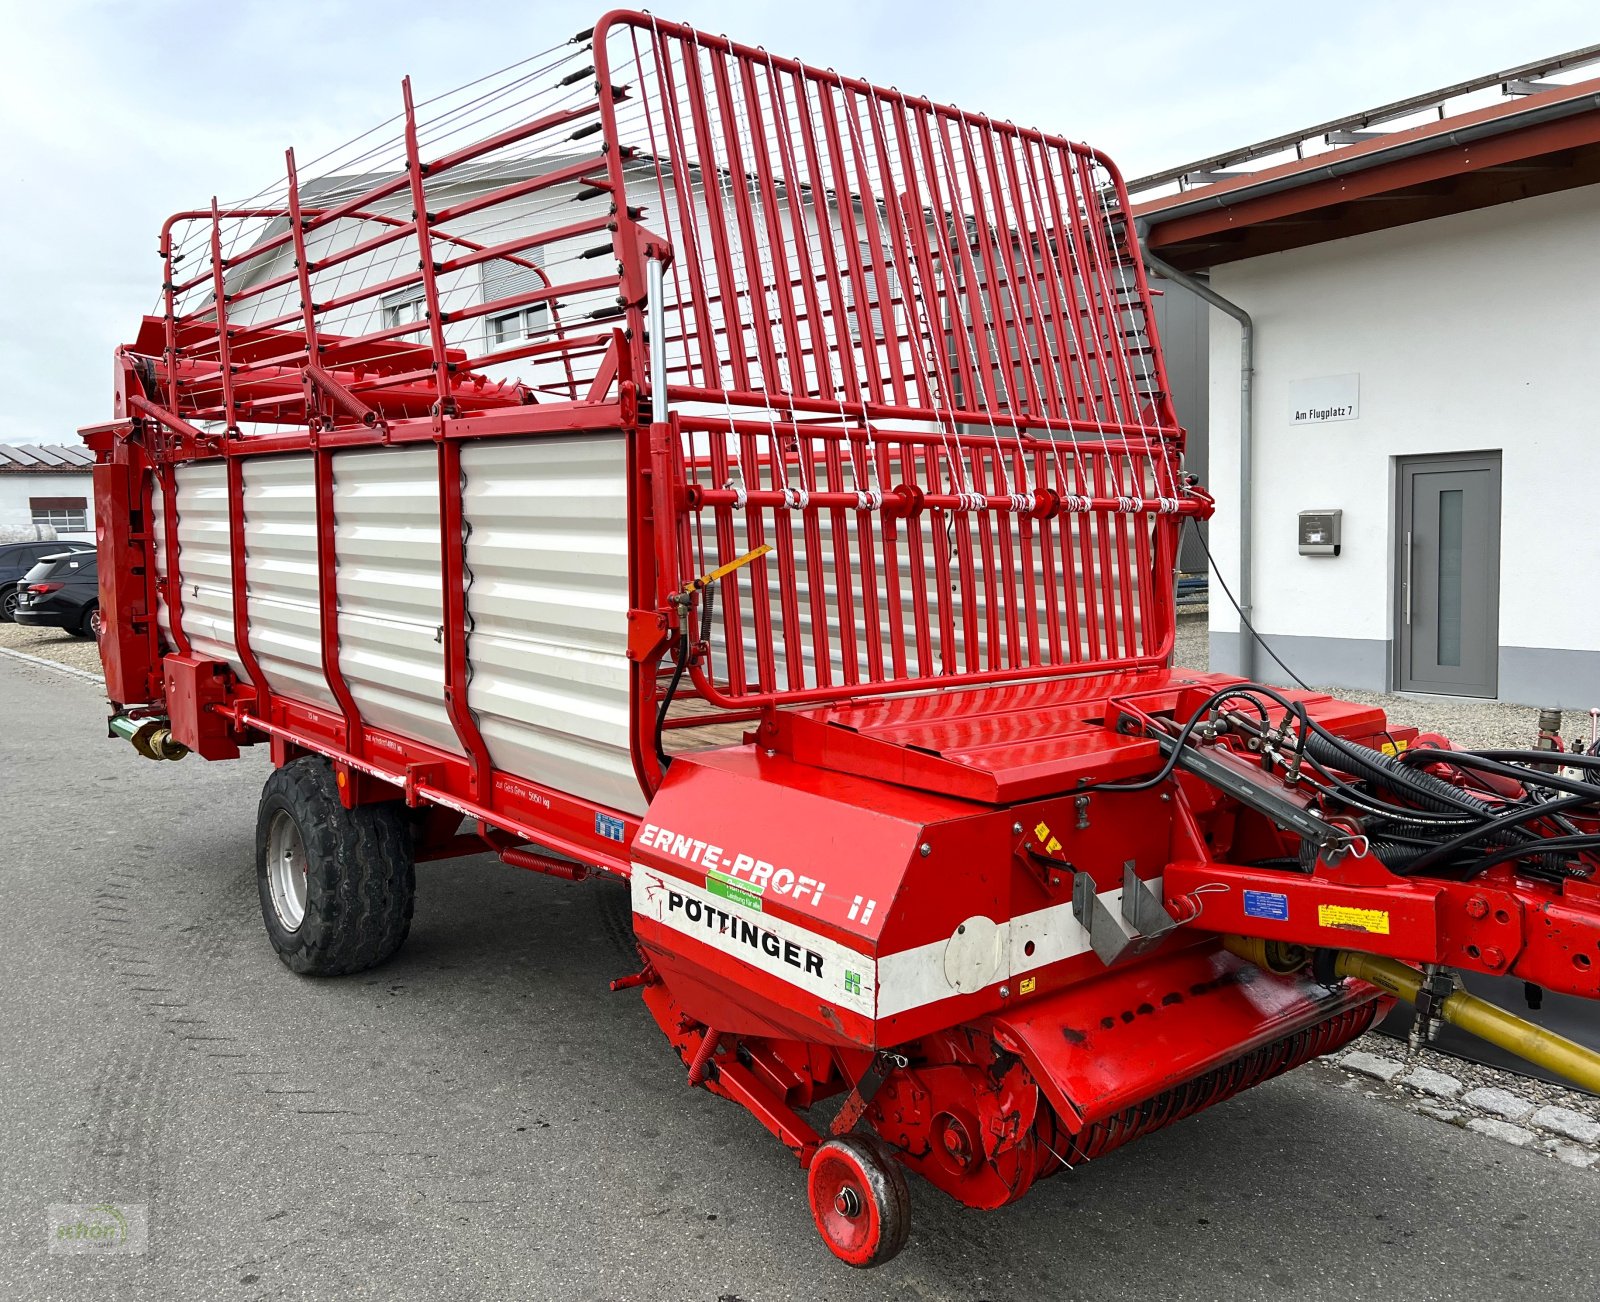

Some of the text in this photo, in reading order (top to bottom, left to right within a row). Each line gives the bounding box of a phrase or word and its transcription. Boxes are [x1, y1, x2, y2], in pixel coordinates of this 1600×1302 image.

[1295, 405, 1352, 420] Am Flugplatz 7
[542, 798, 551, 810] kg
[639, 823, 826, 908] ERNTE-PROFI
[668, 890, 824, 979] PÖTTINGER
